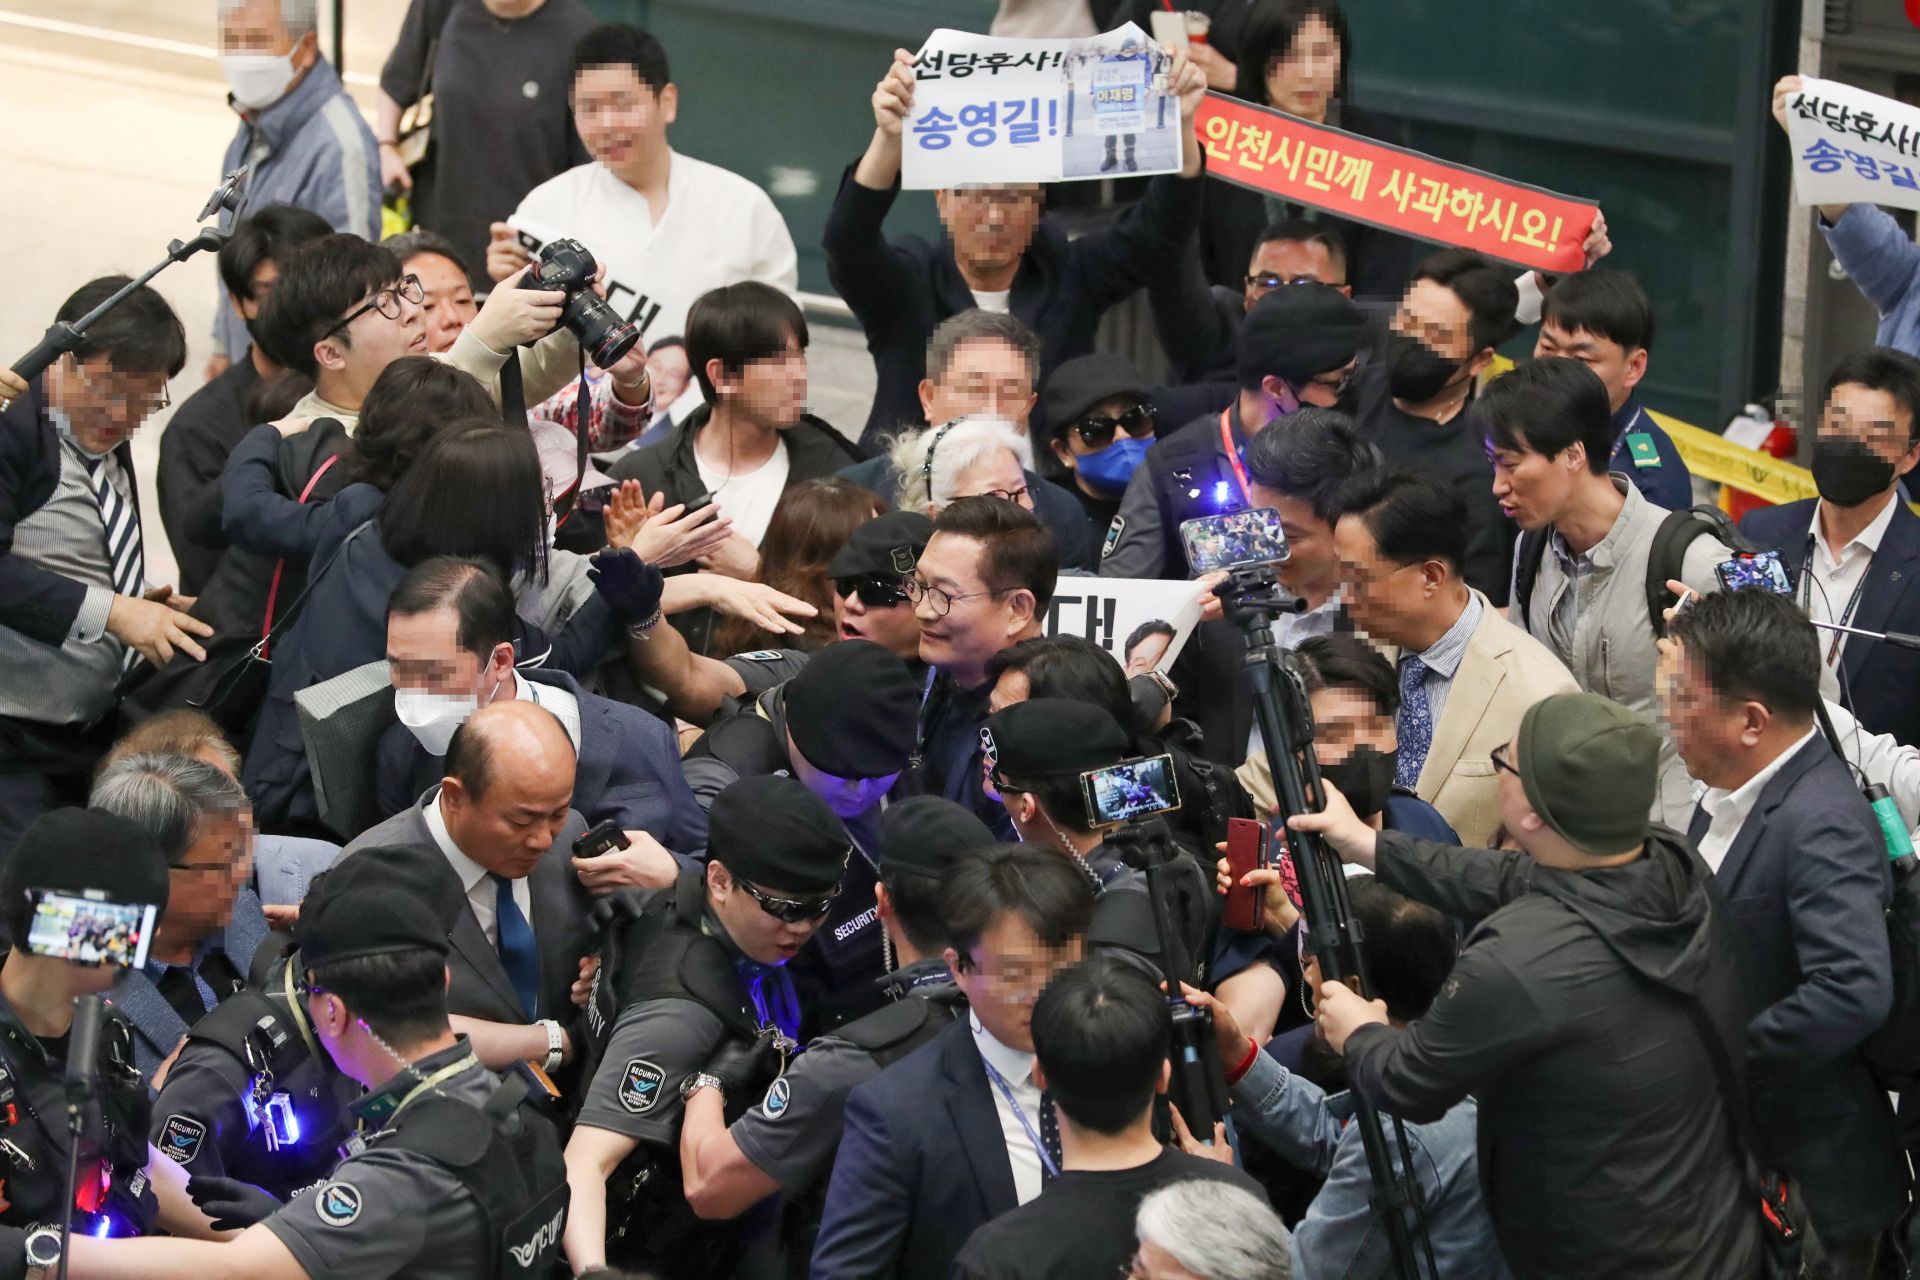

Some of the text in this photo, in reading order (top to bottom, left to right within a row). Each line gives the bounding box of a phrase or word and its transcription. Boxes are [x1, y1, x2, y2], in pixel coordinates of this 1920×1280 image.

[911, 49, 1063, 81] 선당후사!
[912, 97, 1058, 151] 송영길!
[1791, 93, 1920, 158] 선당후사!
[1205, 115, 1563, 253] 인천시민께 사과하시오!
[1802, 137, 1920, 191] 송영길
[1047, 595, 1117, 651] 다!
[834, 905, 879, 941] SECURITY
[629, 1065, 661, 1082] SECURITY
[170, 1120, 201, 1137] SECURITY
